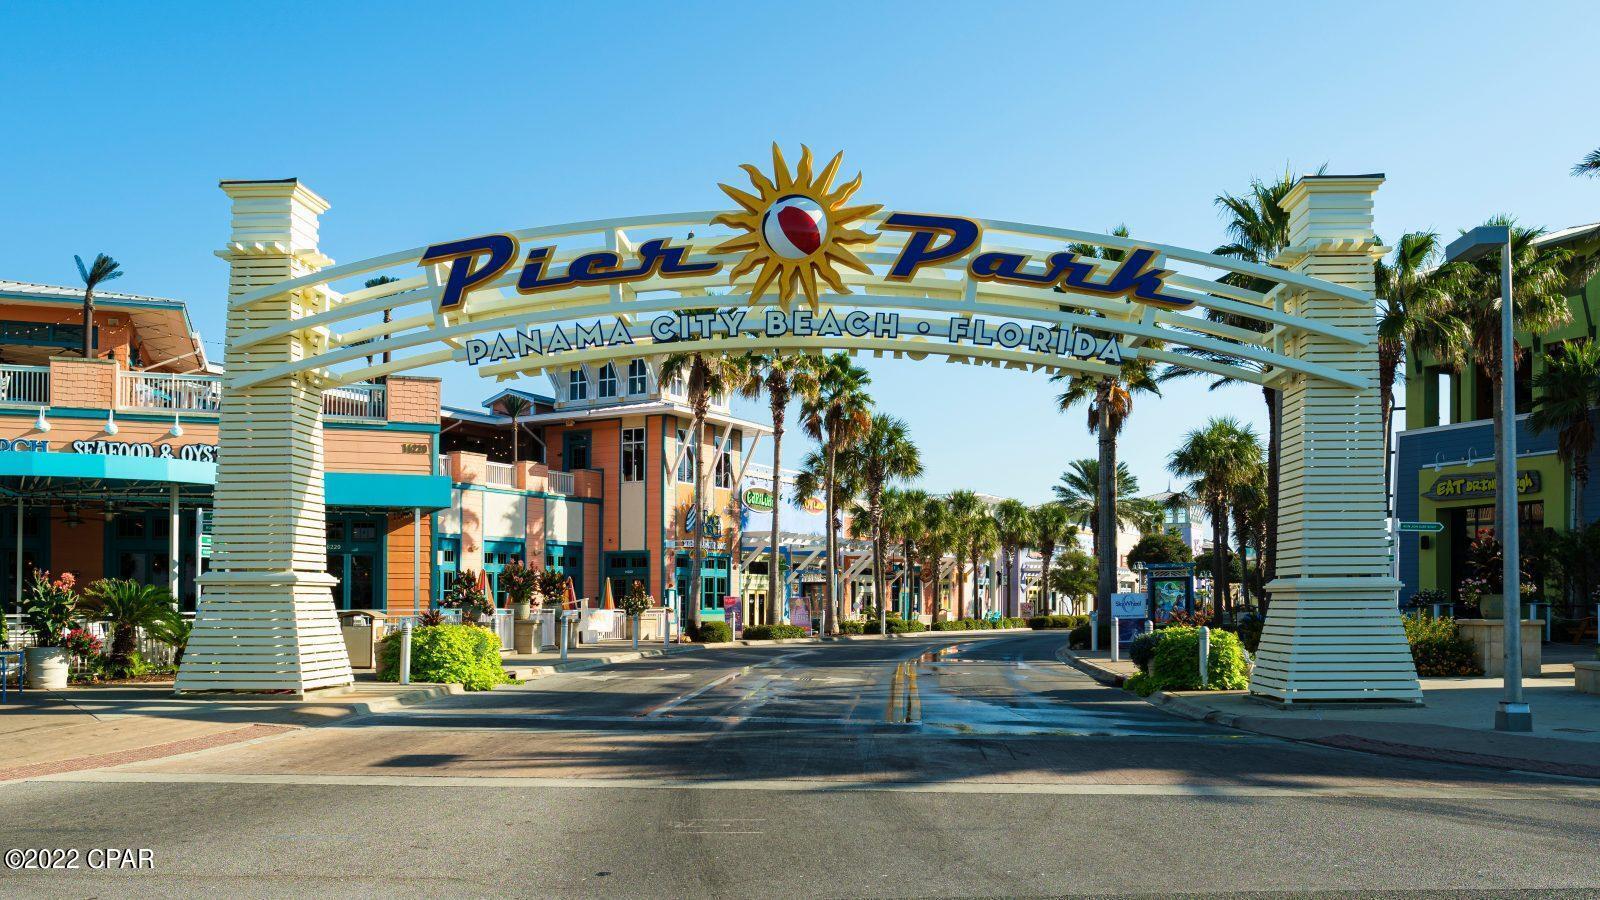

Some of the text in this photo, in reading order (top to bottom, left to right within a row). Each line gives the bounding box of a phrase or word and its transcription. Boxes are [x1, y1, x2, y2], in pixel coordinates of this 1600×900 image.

[417, 210, 1197, 313] Pier Park
[466, 309, 1122, 365] PANAMA CITY BEACH FLORIDA
[1436, 479, 1465, 496] EAT
[1465, 478, 1498, 492] DRIN
